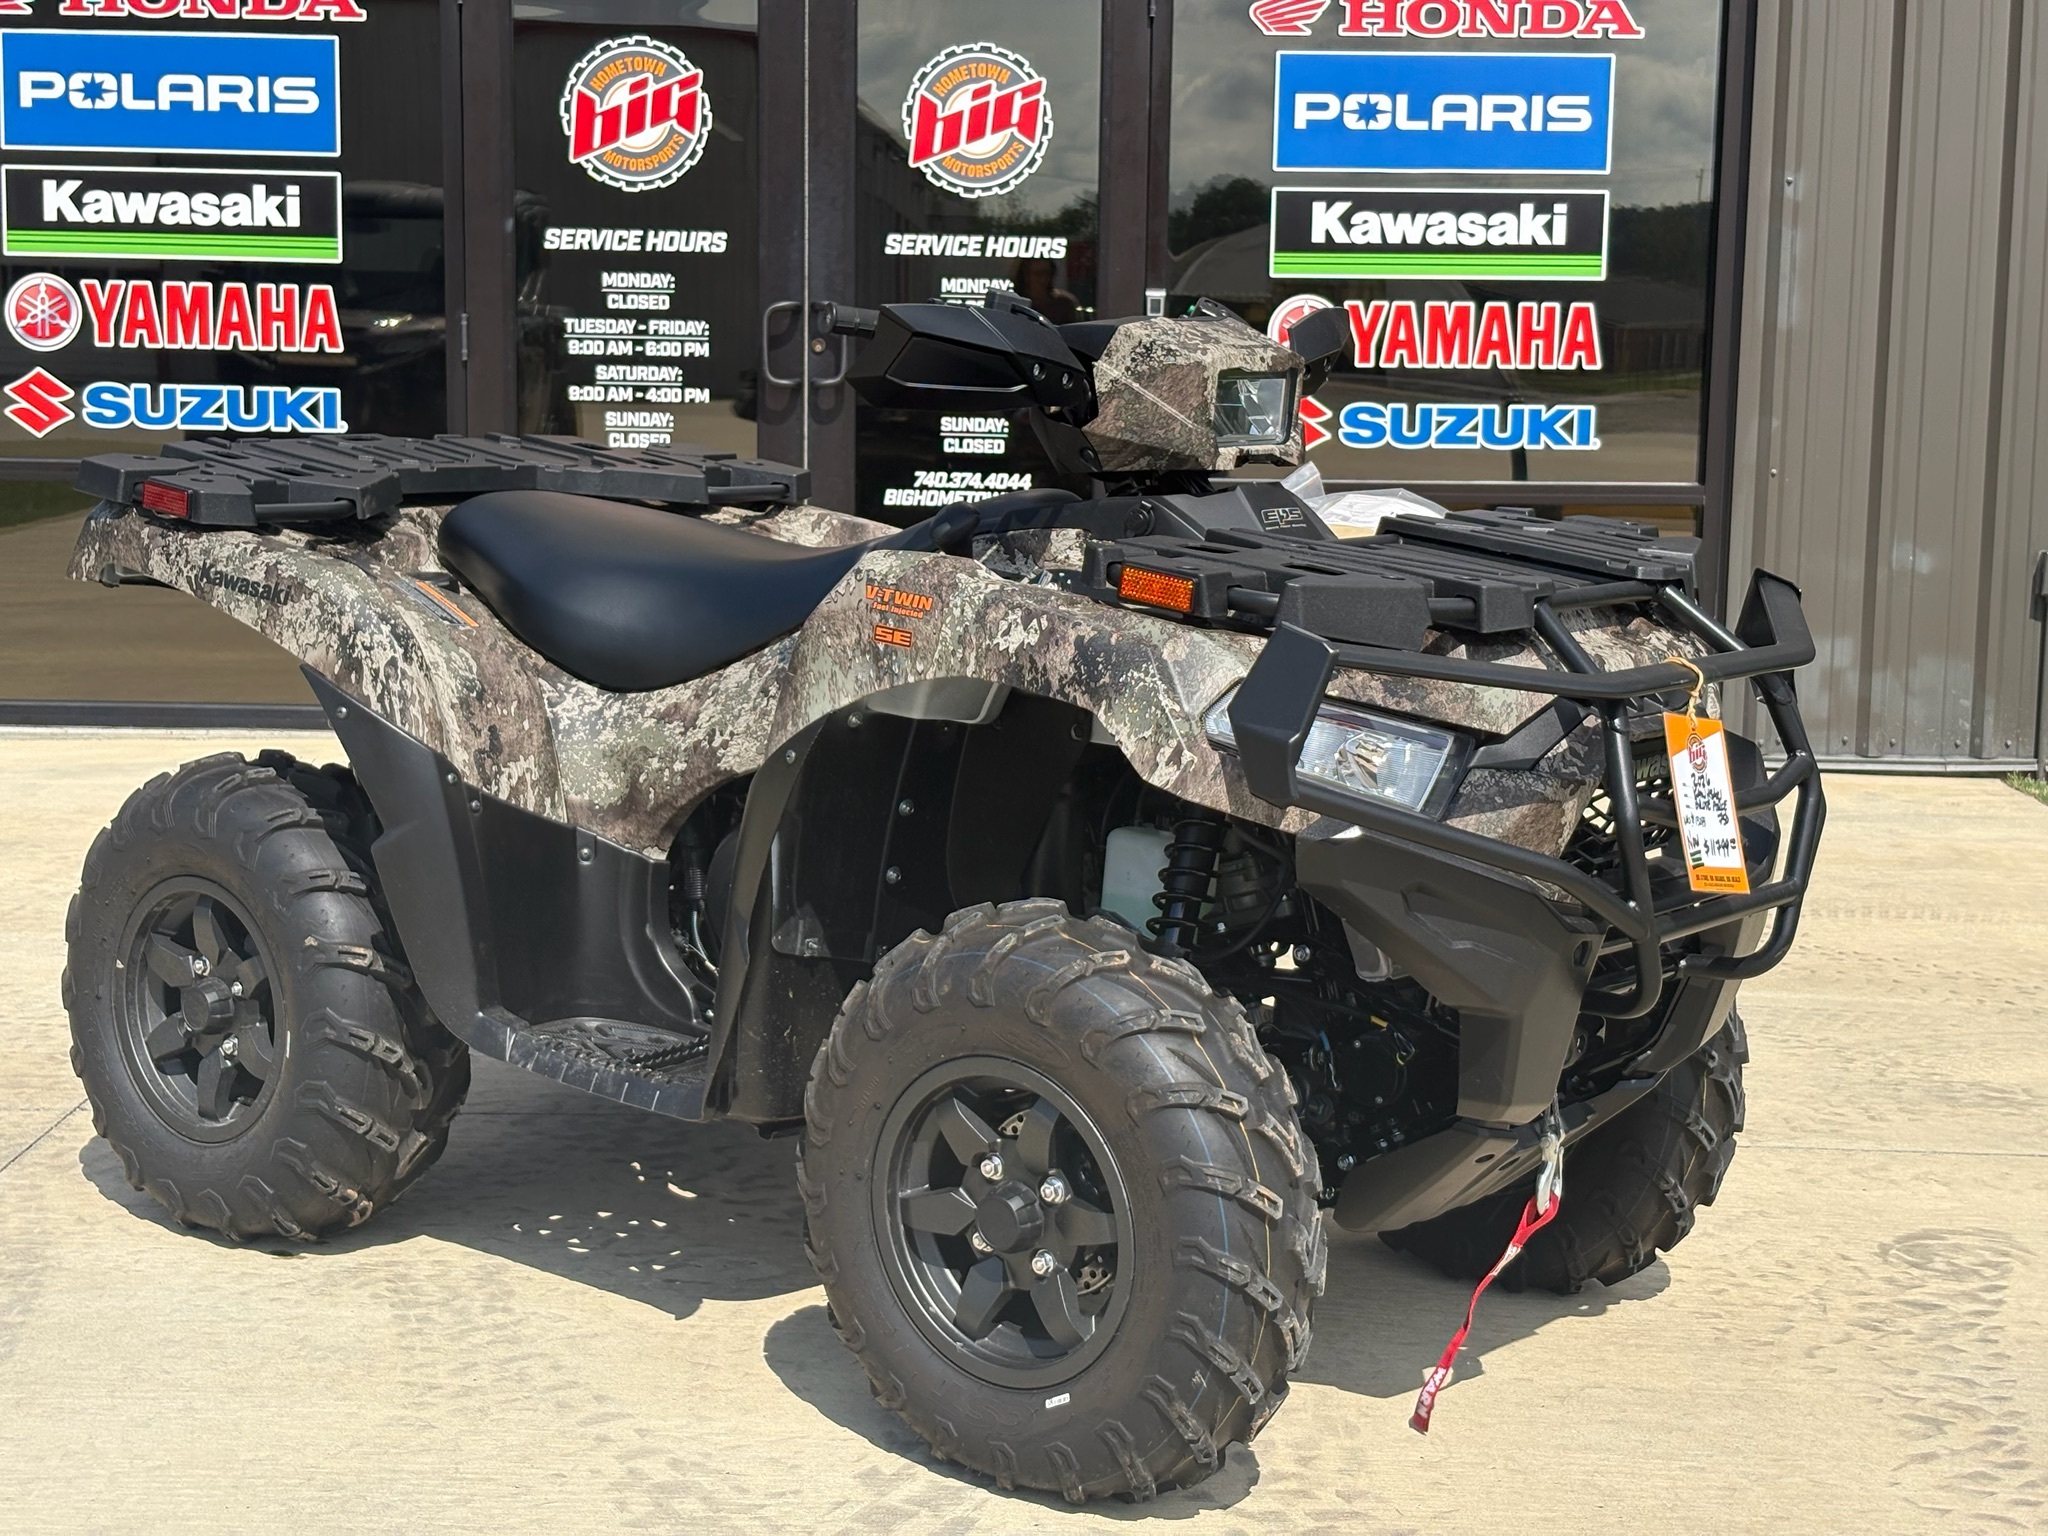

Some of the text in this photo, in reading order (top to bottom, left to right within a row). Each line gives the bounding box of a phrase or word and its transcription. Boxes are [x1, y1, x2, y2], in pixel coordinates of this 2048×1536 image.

[1340, 0, 1643, 37] HONDA
[589, 56, 667, 92] HOMETOWN
[932, 62, 1011, 97] HOMETOWN
[19, 71, 320, 114] POLARIS
[1294, 93, 1593, 132] POLARIS
[603, 133, 686, 171] MOTORSPORTS
[942, 141, 1025, 178] MOTORSPORTS
[42, 179, 301, 228] Kawasaki
[1311, 201, 1568, 246] Kawasaki
[544, 228, 728, 253] SERVICE HOURS
[884, 233, 1067, 259] SERVICE HOURS
[602, 272, 676, 288] MONDAY:
[81, 281, 343, 351] YAMAHA
[607, 294, 670, 310] CLOSED
[564, 318, 636, 334] TUESDAY
[649, 320, 710, 336] FRIDAY:
[1346, 301, 1602, 369] YAMAHA
[606, 341, 633, 355] AM
[684, 342, 710, 357] PM
[596, 365, 683, 382] SATURDAY:
[85, 383, 342, 432] SUZUKI
[606, 387, 633, 402] AM
[645, 388, 682, 402] 4:00
[684, 388, 710, 403] PM
[605, 411, 674, 427] SUNDAY:
[940, 416, 1009, 433] SUNDAY:
[1341, 404, 1596, 448] SUZUKI
[943, 438, 1005, 454] CLOSED
[914, 471, 1032, 490] 740.374.4044
[200, 560, 292, 605] Kawasaki
[866, 585, 933, 611] V-TWIN
[875, 626, 912, 646] SE
